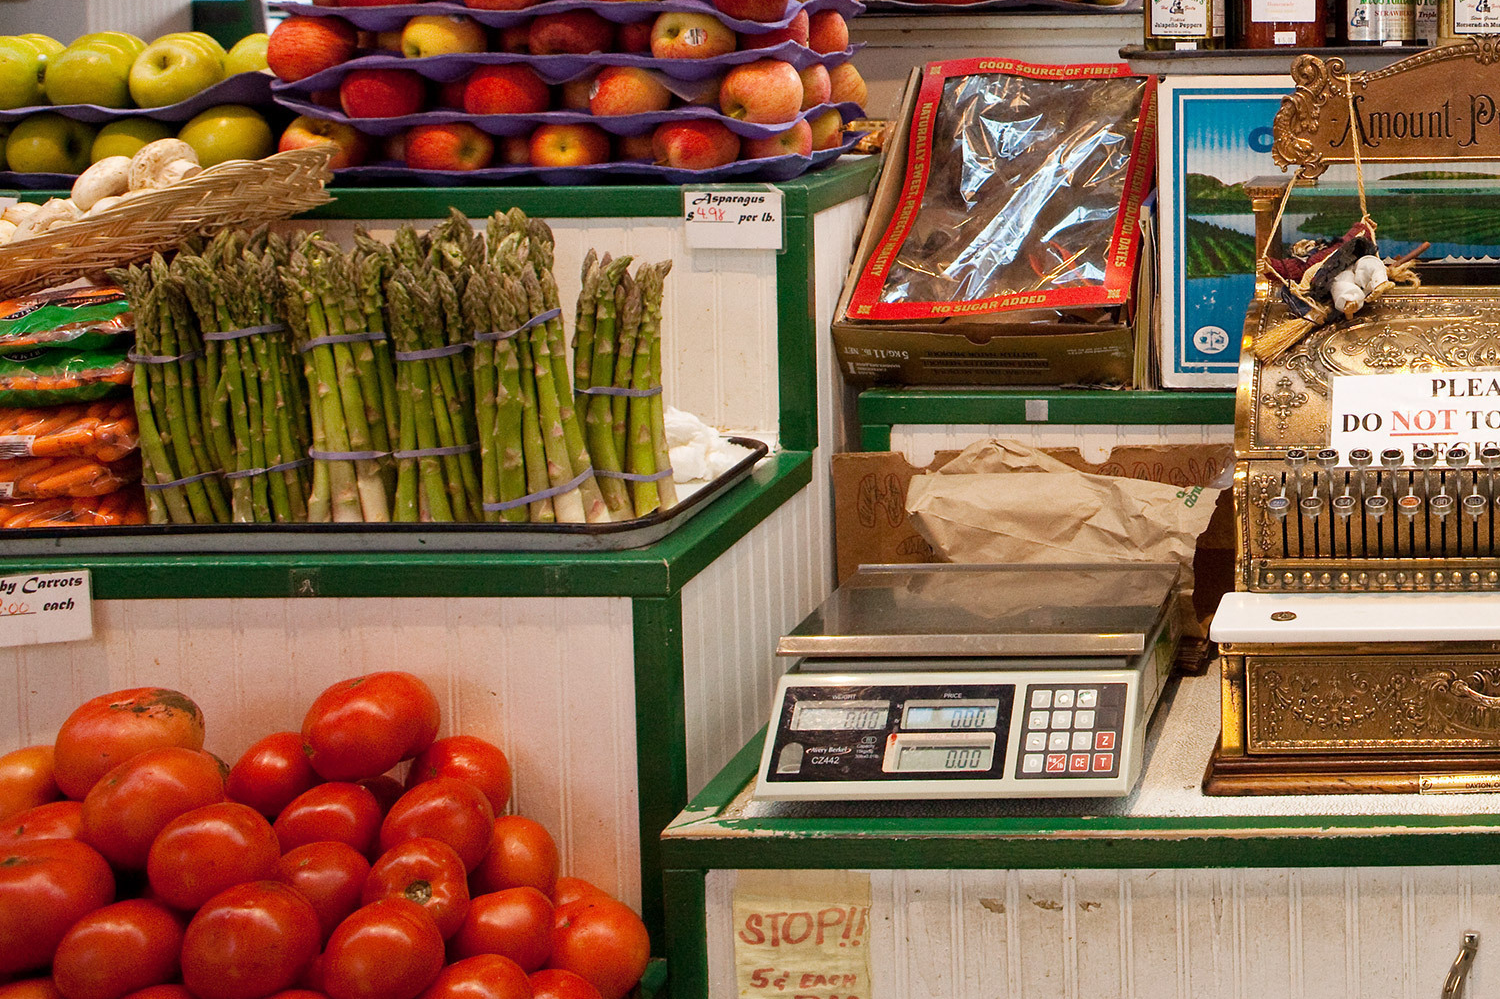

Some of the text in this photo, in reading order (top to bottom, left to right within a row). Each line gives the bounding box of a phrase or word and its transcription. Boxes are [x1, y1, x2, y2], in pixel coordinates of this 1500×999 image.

[979, 61, 1118, 76] GOOD SOURCE OF FIBER
[1329, 95, 1454, 148] Amount
[915, 102, 933, 161] NATURALLY
[692, 193, 765, 207] Asparagus
[738, 213, 758, 225] per
[761, 212, 776, 222] lb.
[1121, 192, 1141, 235] MEDJOOL
[1114, 237, 1132, 268] DATES
[931, 295, 1046, 314] NO SUGAR ADDED
[1342, 412, 1384, 432] DO
[1391, 410, 1457, 431] NOT
[22, 576, 83, 594] Carrots
[43, 597, 75, 611] each
[1038, 695, 1044, 703] 7
[950, 709, 986, 728] 0.00
[1101, 736, 1109, 746] Z
[811, 756, 840, 765] CZ442
[944, 750, 982, 769] 0.00
[1074, 757, 1085, 767] CE
[1100, 757, 1107, 768] T
[738, 906, 868, 947] STOP!!
[799, 973, 857, 989] EACH
